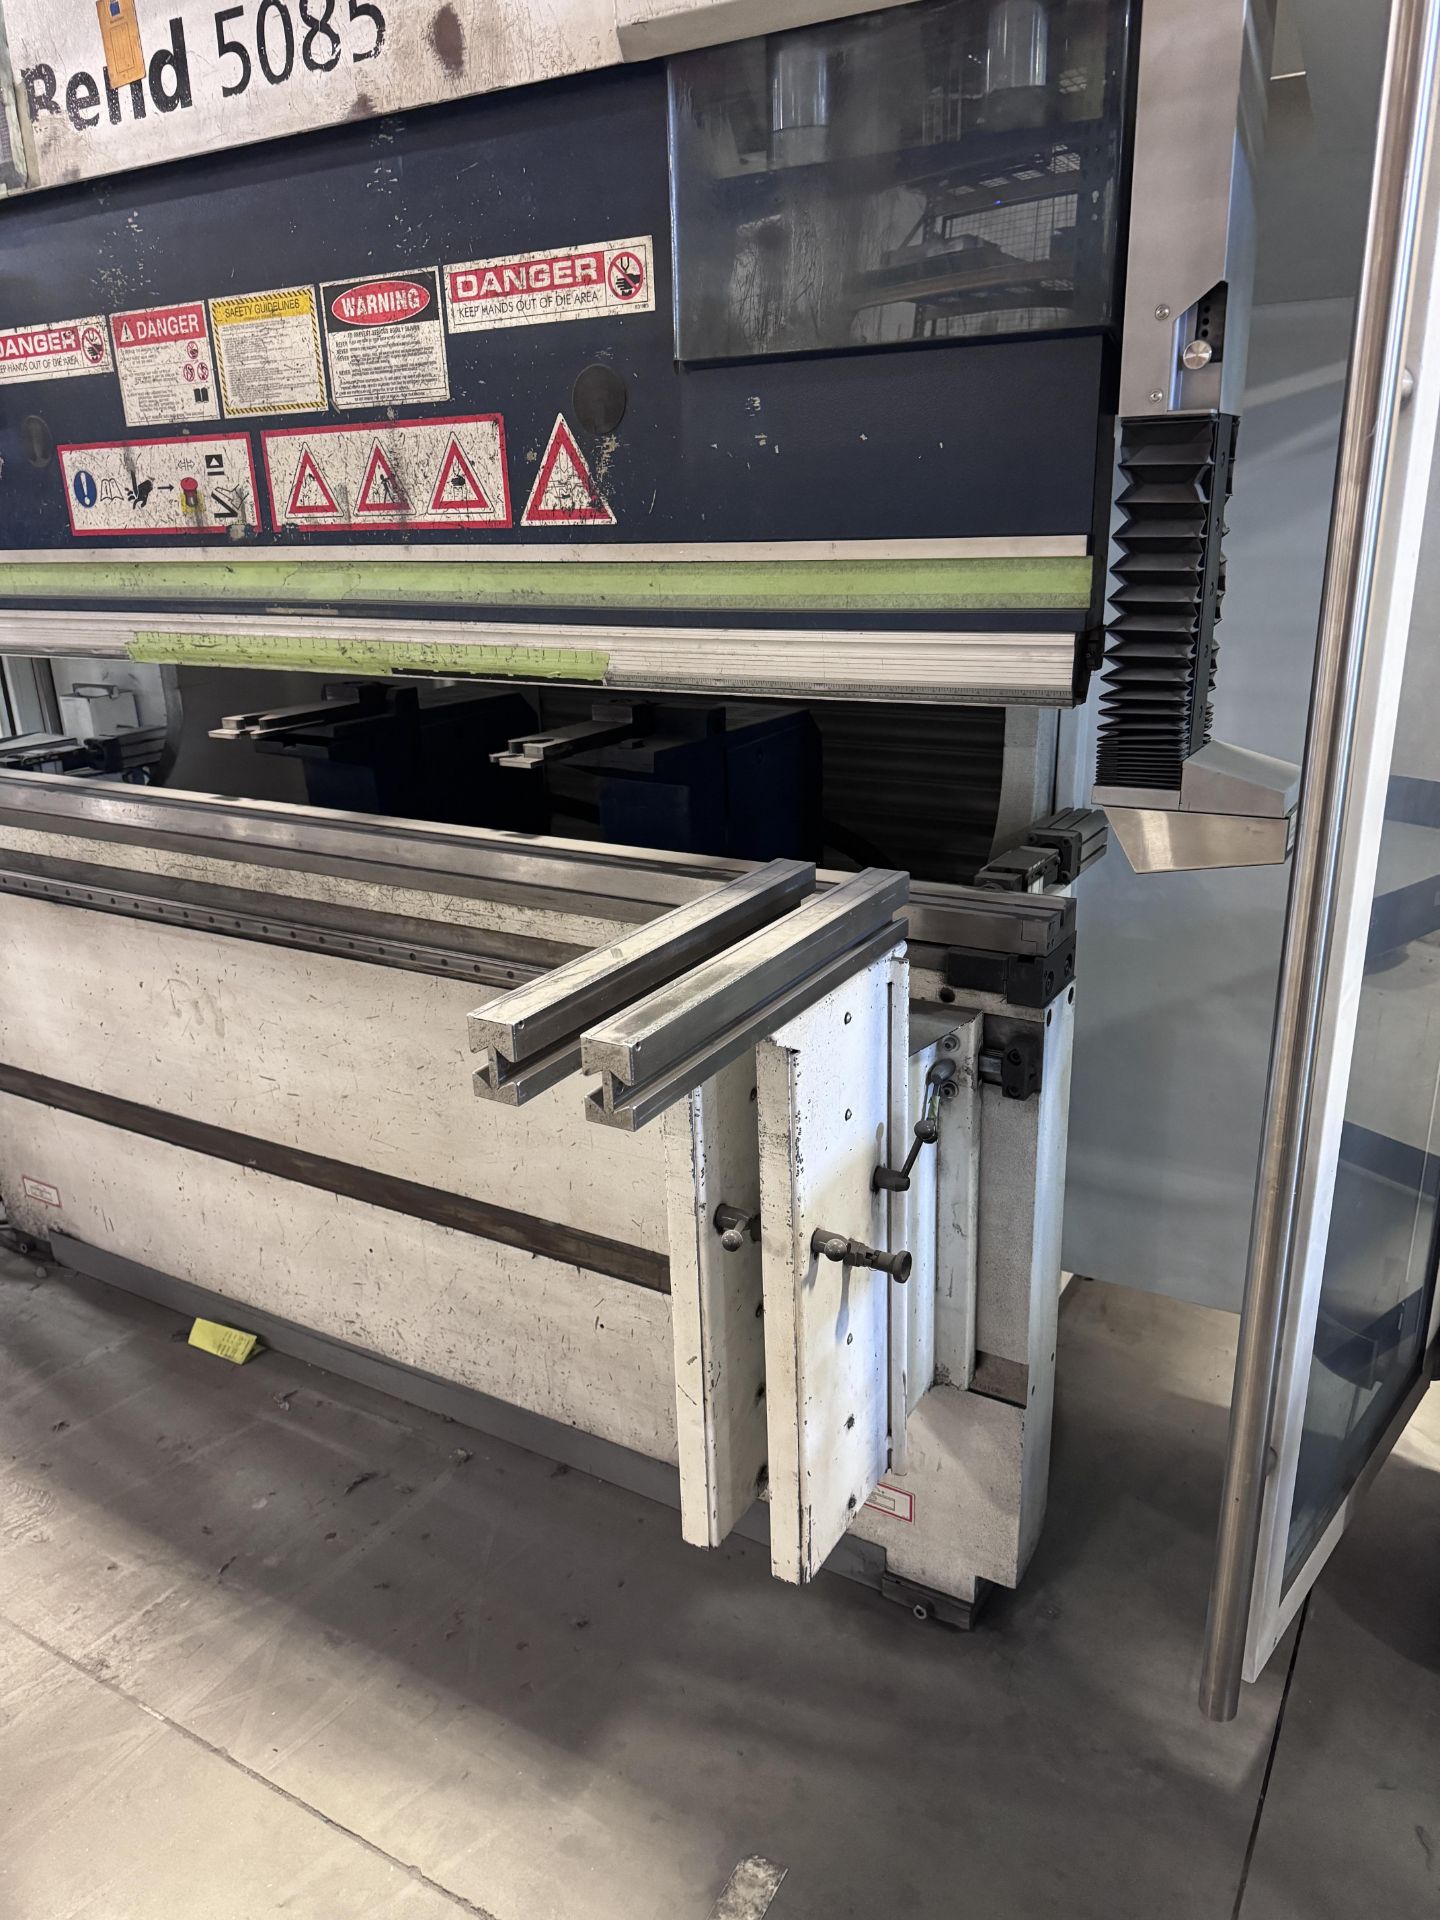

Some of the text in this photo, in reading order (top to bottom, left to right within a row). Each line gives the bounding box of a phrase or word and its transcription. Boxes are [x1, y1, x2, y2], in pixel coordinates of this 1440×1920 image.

[214, 0, 386, 98] 5085
[456, 257, 598, 299] DANGER
[224, 304, 253, 319] SAFETY
[254, 298, 300, 315] GUIDELINES
[341, 288, 420, 318] WARNING
[458, 290, 598, 318] KEEP HANDS OUT OF DIE AREA
[136, 313, 200, 340] DANGER
[7, 361, 28, 373] HANDS
[28, 360, 41, 370] OUT
[42, 358, 52, 369] OF
